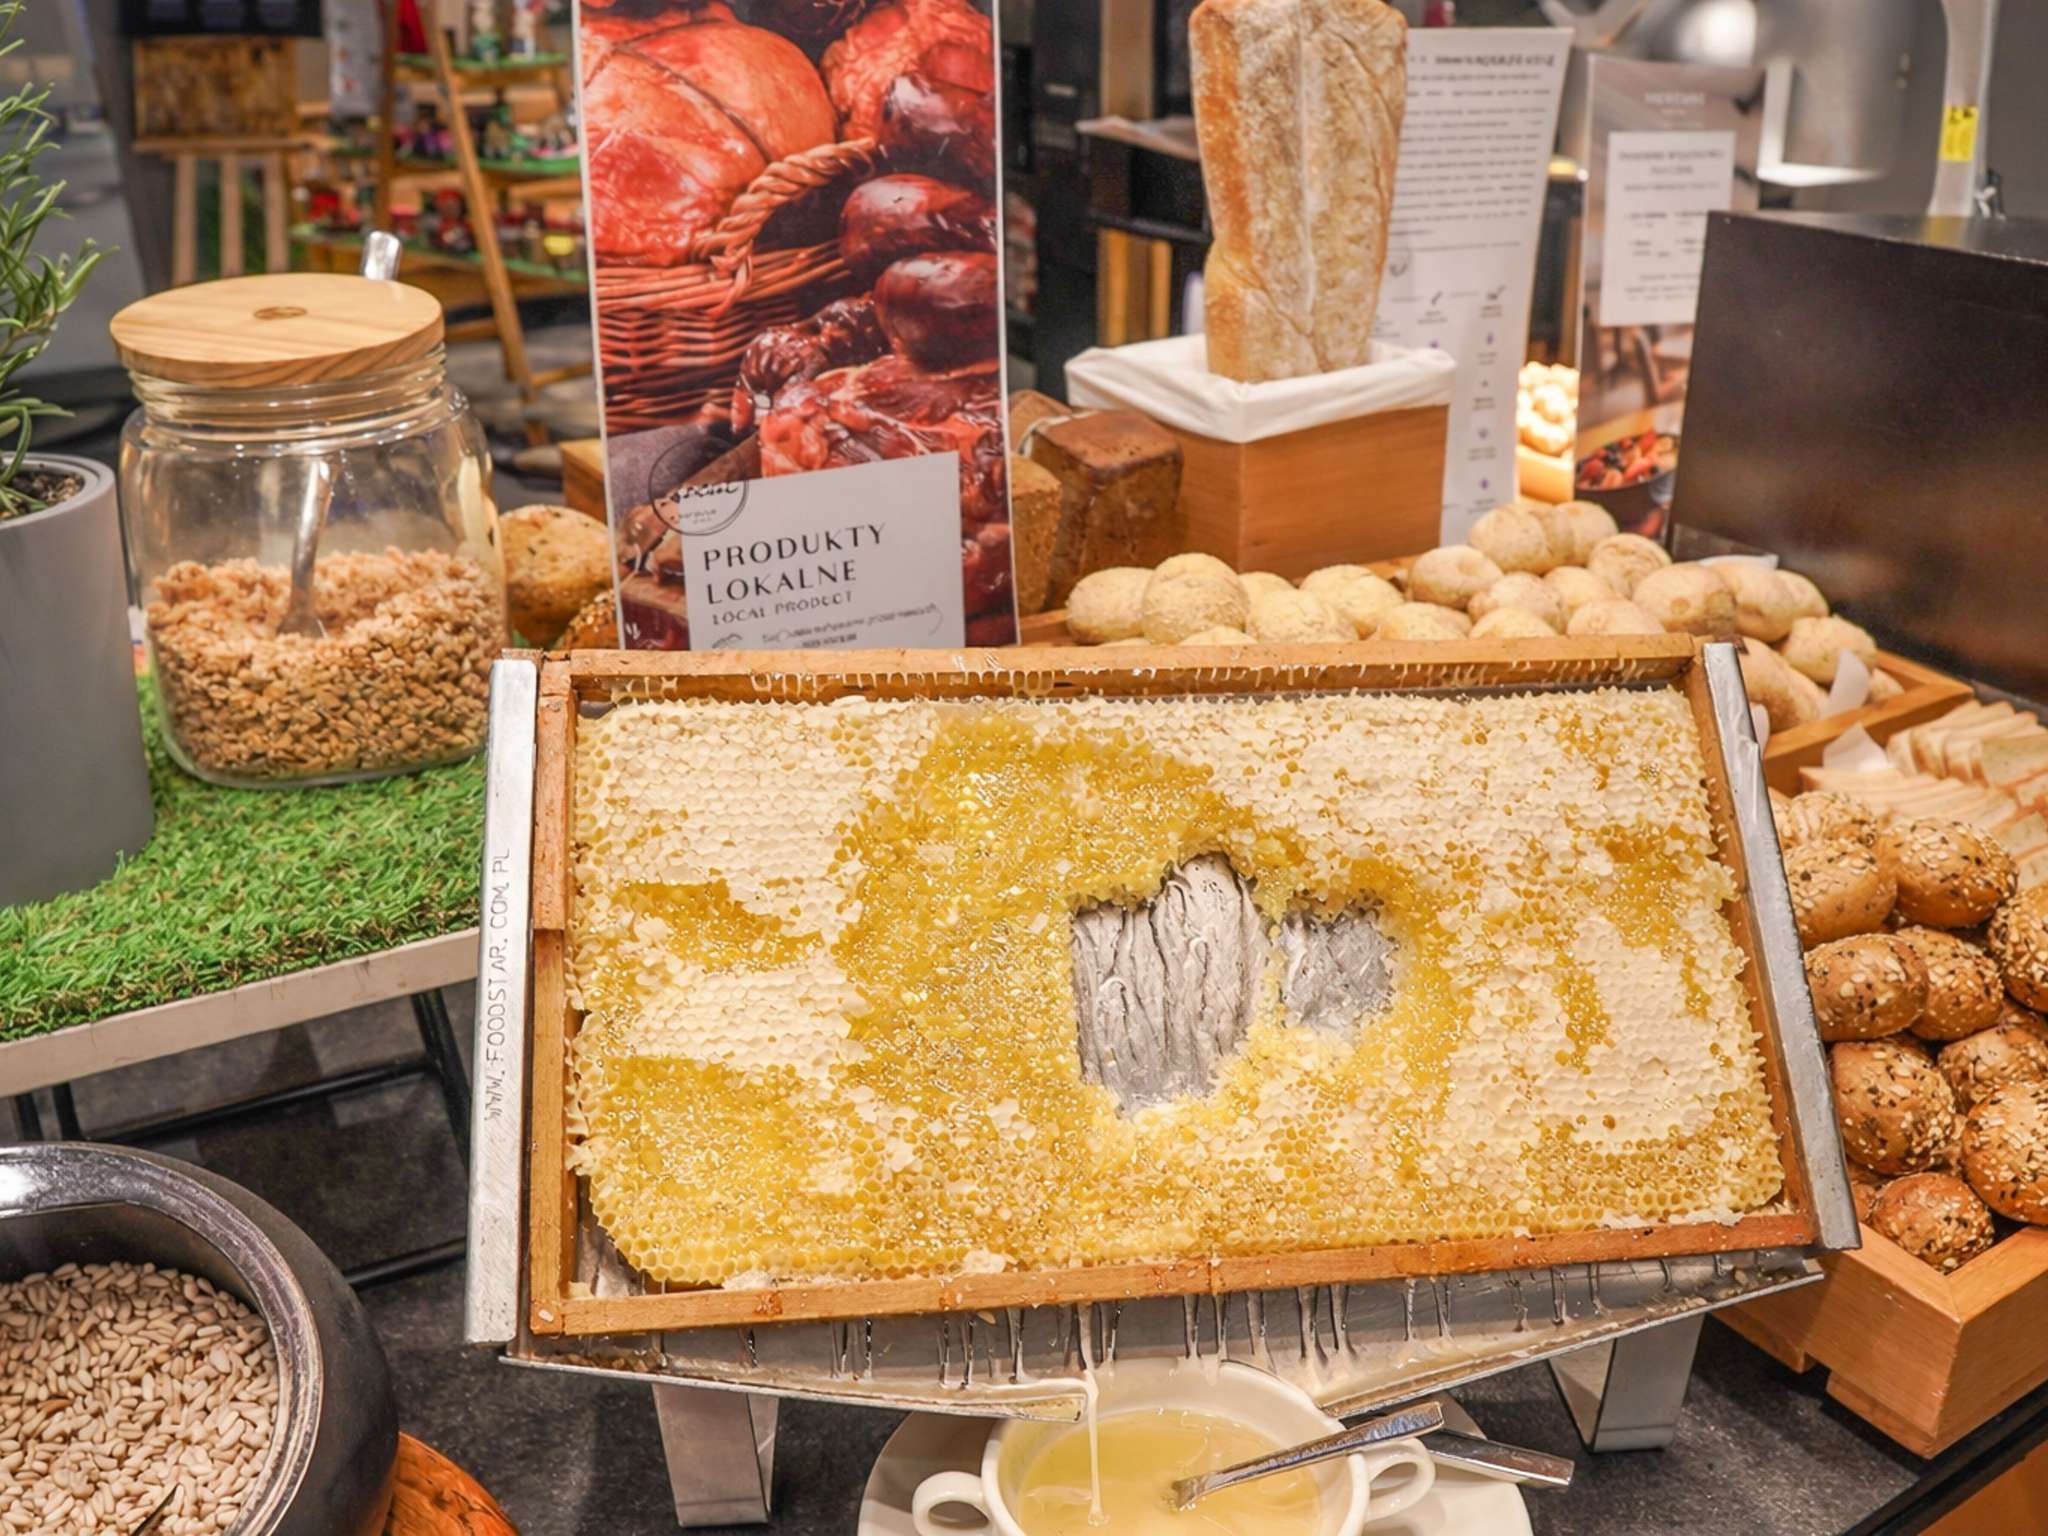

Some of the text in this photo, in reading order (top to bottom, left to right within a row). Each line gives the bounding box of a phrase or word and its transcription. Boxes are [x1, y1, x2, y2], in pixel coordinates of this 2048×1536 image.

[704, 522, 886, 572] PRODUKTY
[706, 558, 857, 605] LOKALNE
[712, 607, 766, 625] LOCAL
